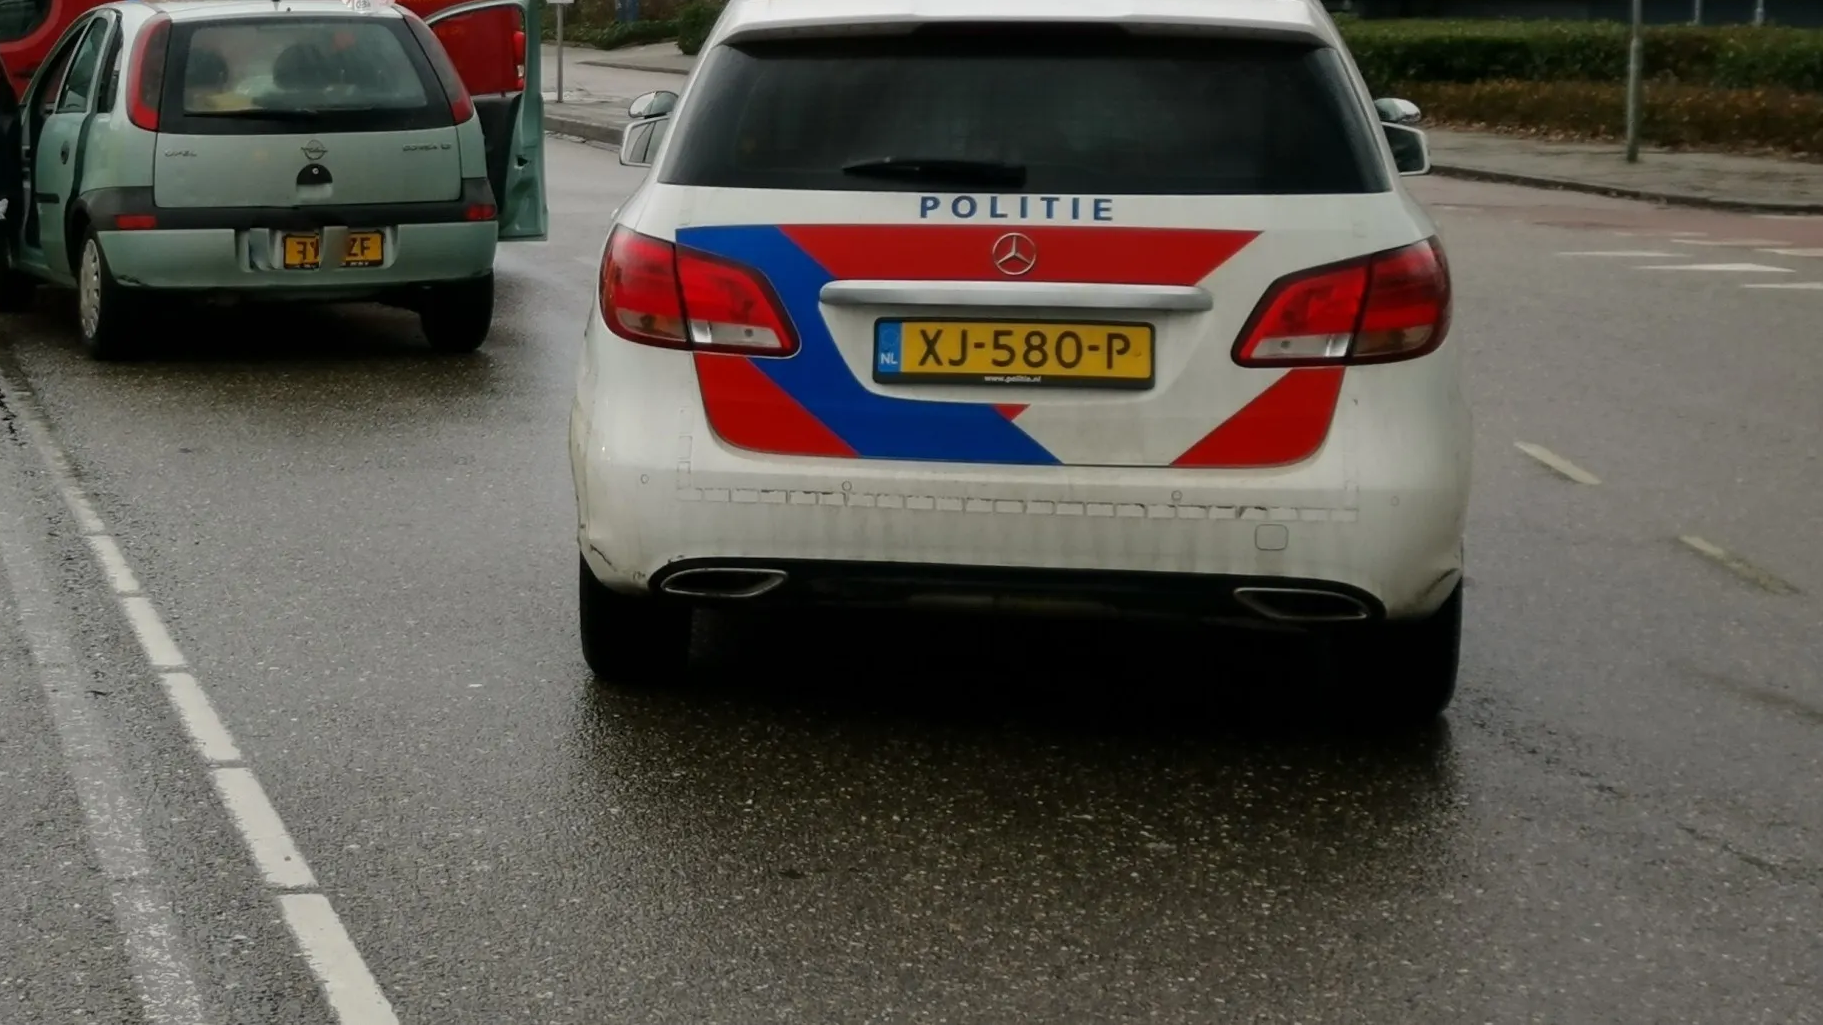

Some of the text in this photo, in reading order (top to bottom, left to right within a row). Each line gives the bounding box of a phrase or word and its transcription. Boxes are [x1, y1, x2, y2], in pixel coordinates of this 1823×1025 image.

[919, 195, 1113, 221] POLITIE
[880, 353, 898, 365] NL
[918, 329, 1131, 370] XJ-580-P
[984, 375, 1042, 384] www.politie.nl
